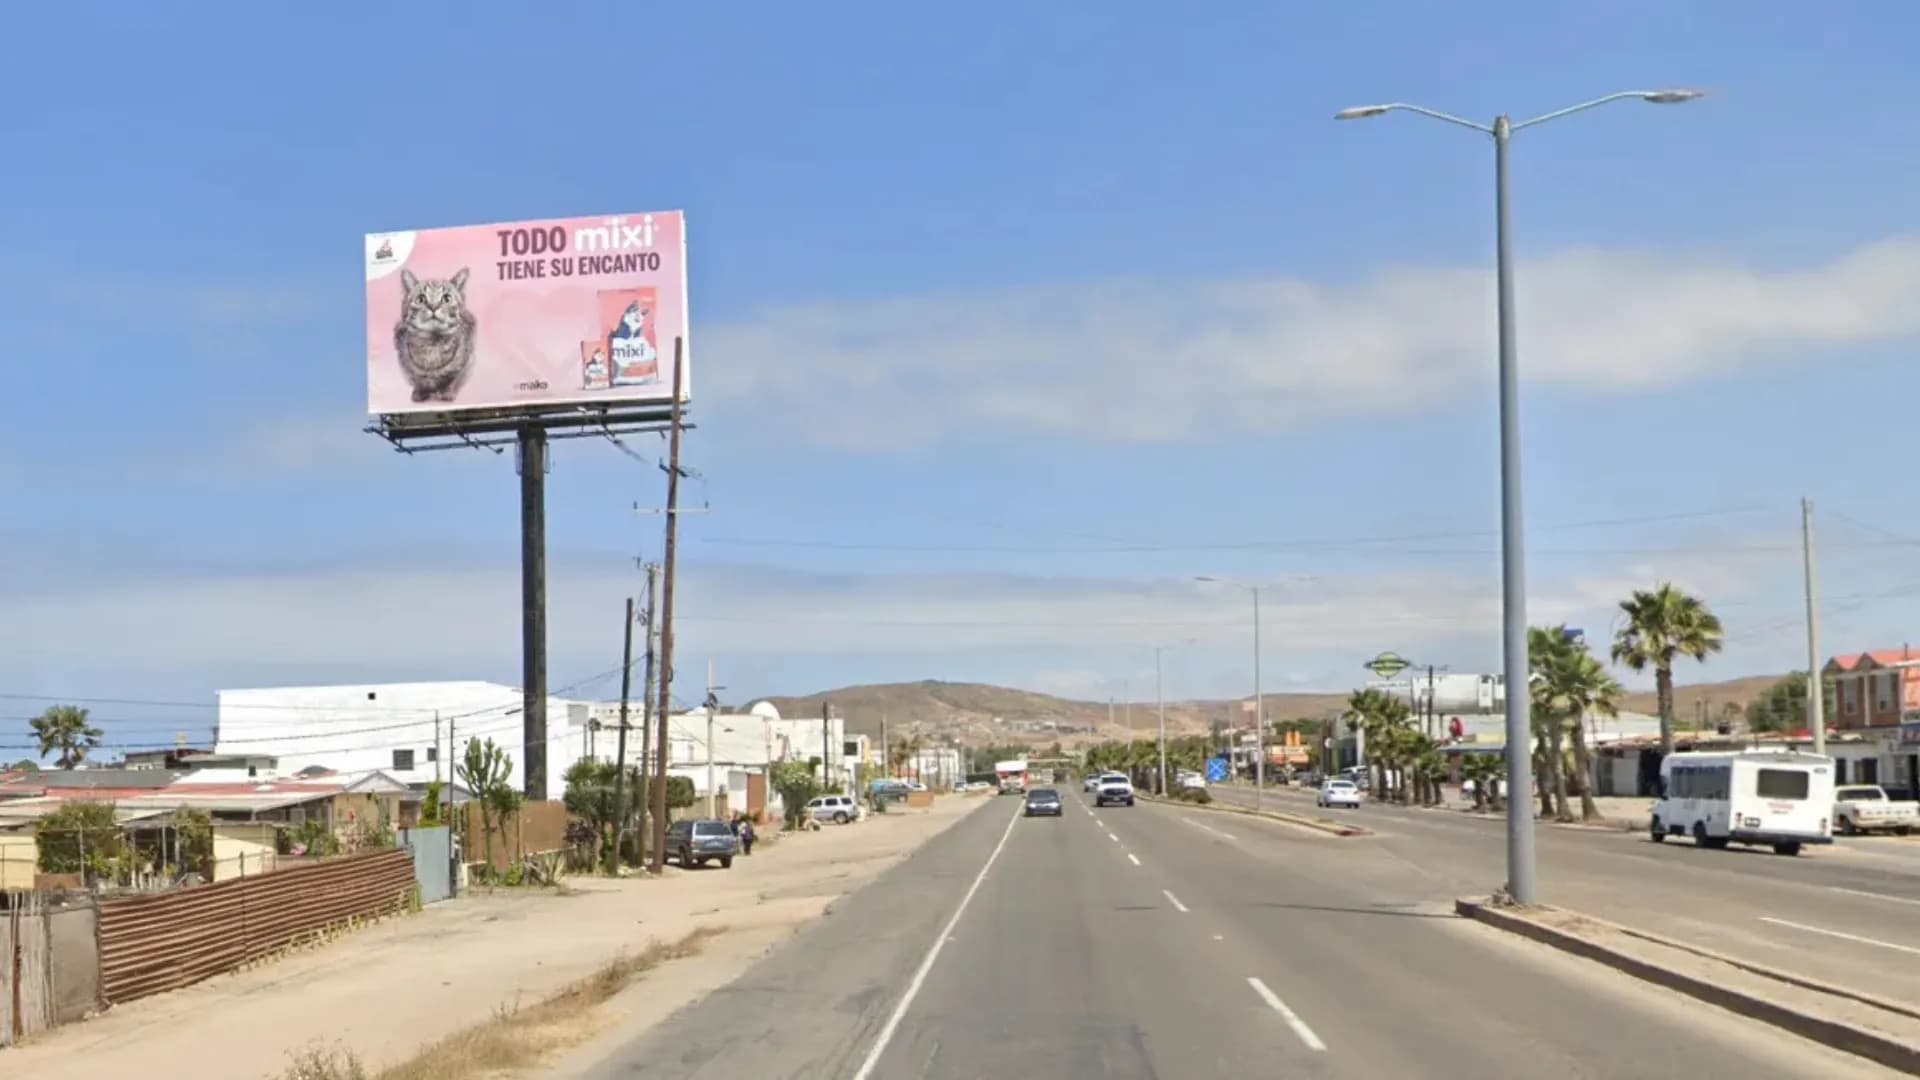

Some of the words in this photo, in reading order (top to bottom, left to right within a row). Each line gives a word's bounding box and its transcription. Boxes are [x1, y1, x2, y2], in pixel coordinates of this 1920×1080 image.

[497, 226, 566, 256] TODO
[575, 214, 652, 251] mixi
[497, 259, 546, 280] TIENE
[550, 257, 573, 277] SU
[578, 252, 660, 275] ENCANTO
[612, 343, 644, 358] mixi
